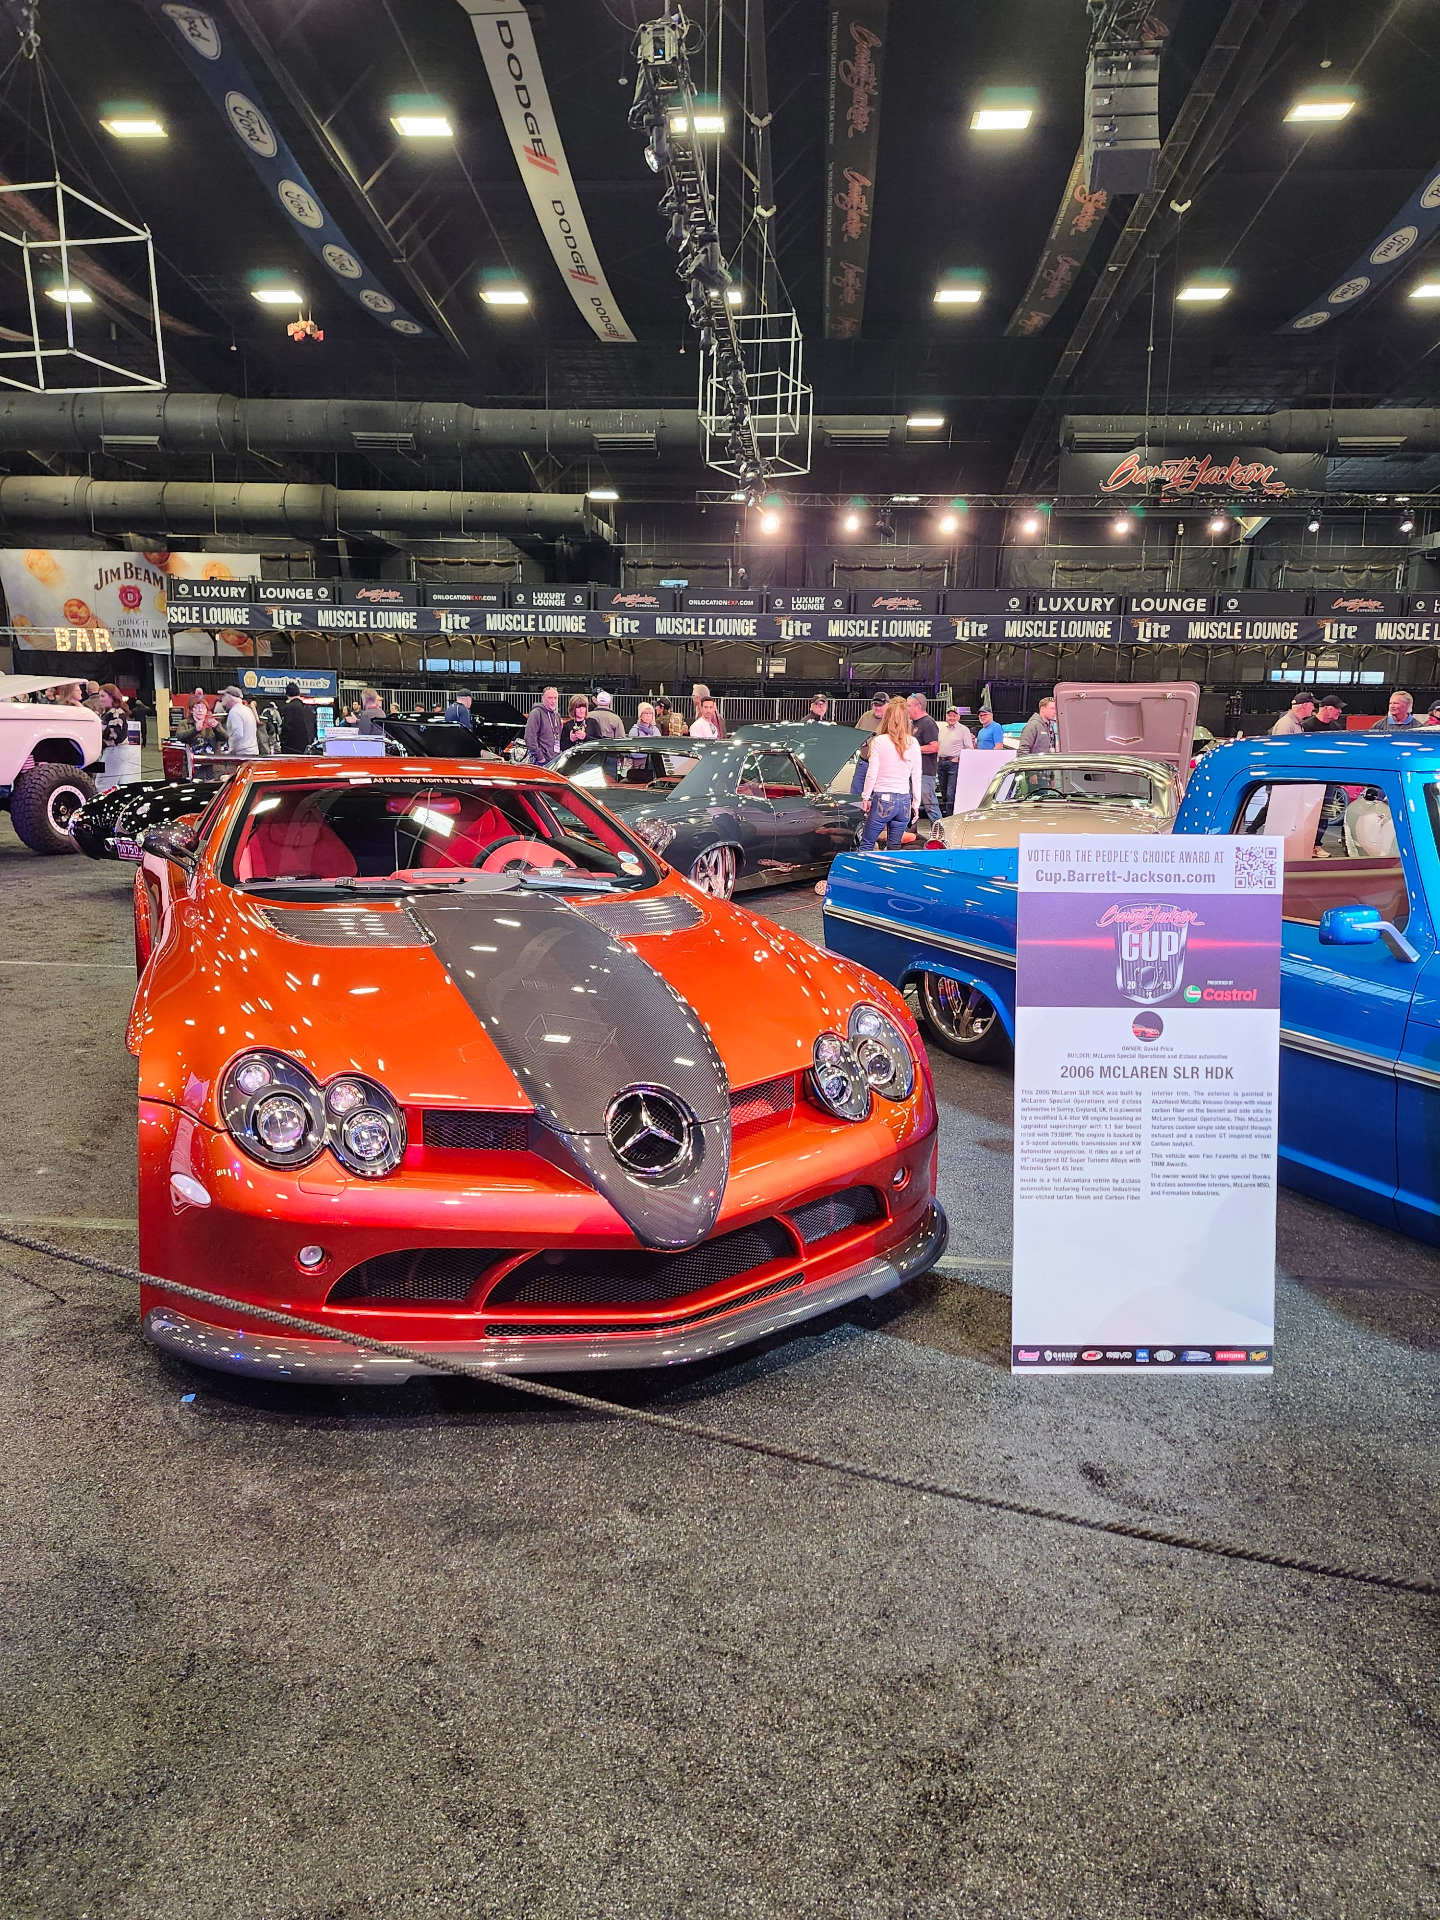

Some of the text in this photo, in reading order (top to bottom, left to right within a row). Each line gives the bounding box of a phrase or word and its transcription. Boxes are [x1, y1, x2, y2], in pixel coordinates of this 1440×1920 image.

[496, 20, 547, 158] DODGE
[838, 20, 883, 139] Barrett-Jackson
[233, 106, 267, 145] Ford
[285, 190, 314, 219] Ford
[551, 200, 589, 276] DODGE
[1377, 234, 1410, 258] Ford
[328, 251, 354, 272] Ford
[1335, 282, 1363, 299] Ford
[590, 297, 618, 336] DODGE
[1099, 453, 1286, 492] Barrett-Jackson
[94, 562, 164, 590] JIM BEAM
[194, 586, 247, 598] LUXURY
[259, 587, 313, 600] LOUNGE
[1038, 598, 1115, 611] LUXURY
[1131, 598, 1207, 612] LOUNGE
[203, 607, 250, 625] LOUNGE
[272, 609, 302, 629] Lite
[318, 610, 417, 629] MUSCLE LOUNGE
[439, 614, 470, 633] Lite
[486, 614, 586, 632] MUSCLE LOUNGE
[120, 628, 148, 638] DAMN
[152, 630, 168, 639] WA
[608, 617, 640, 637] Lite
[656, 617, 757, 636] MUSCLE LOUNGE
[779, 620, 812, 640] Lite
[828, 620, 932, 638] MUSCLE LOUNGE
[955, 621, 988, 641] Lite
[1005, 620, 1112, 638] MUSCLE LOUNGE
[1136, 622, 1171, 642] Lite
[1188, 621, 1298, 640] MUSCLE LOUNGE
[1322, 623, 1358, 643] Lite
[1375, 622, 1432, 640] MUSCLE
[54, 627, 115, 652] BAR
[295, 677, 330, 689] Anne's
[1027, 849, 1224, 864] VOTE FOR THE PEOPLE'S CHOICE AWARD AT
[1036, 869, 1215, 885] Cup.Barrett-Jackson.com
[1096, 903, 1205, 933] Barrett-Jackson
[1121, 930, 1178, 962] CUP
[1127, 981, 1172, 990] 20 25
[1202, 988, 1258, 1001] Castrol
[1060, 1066, 1234, 1079] 2006 MCLAREN SLR HDK
